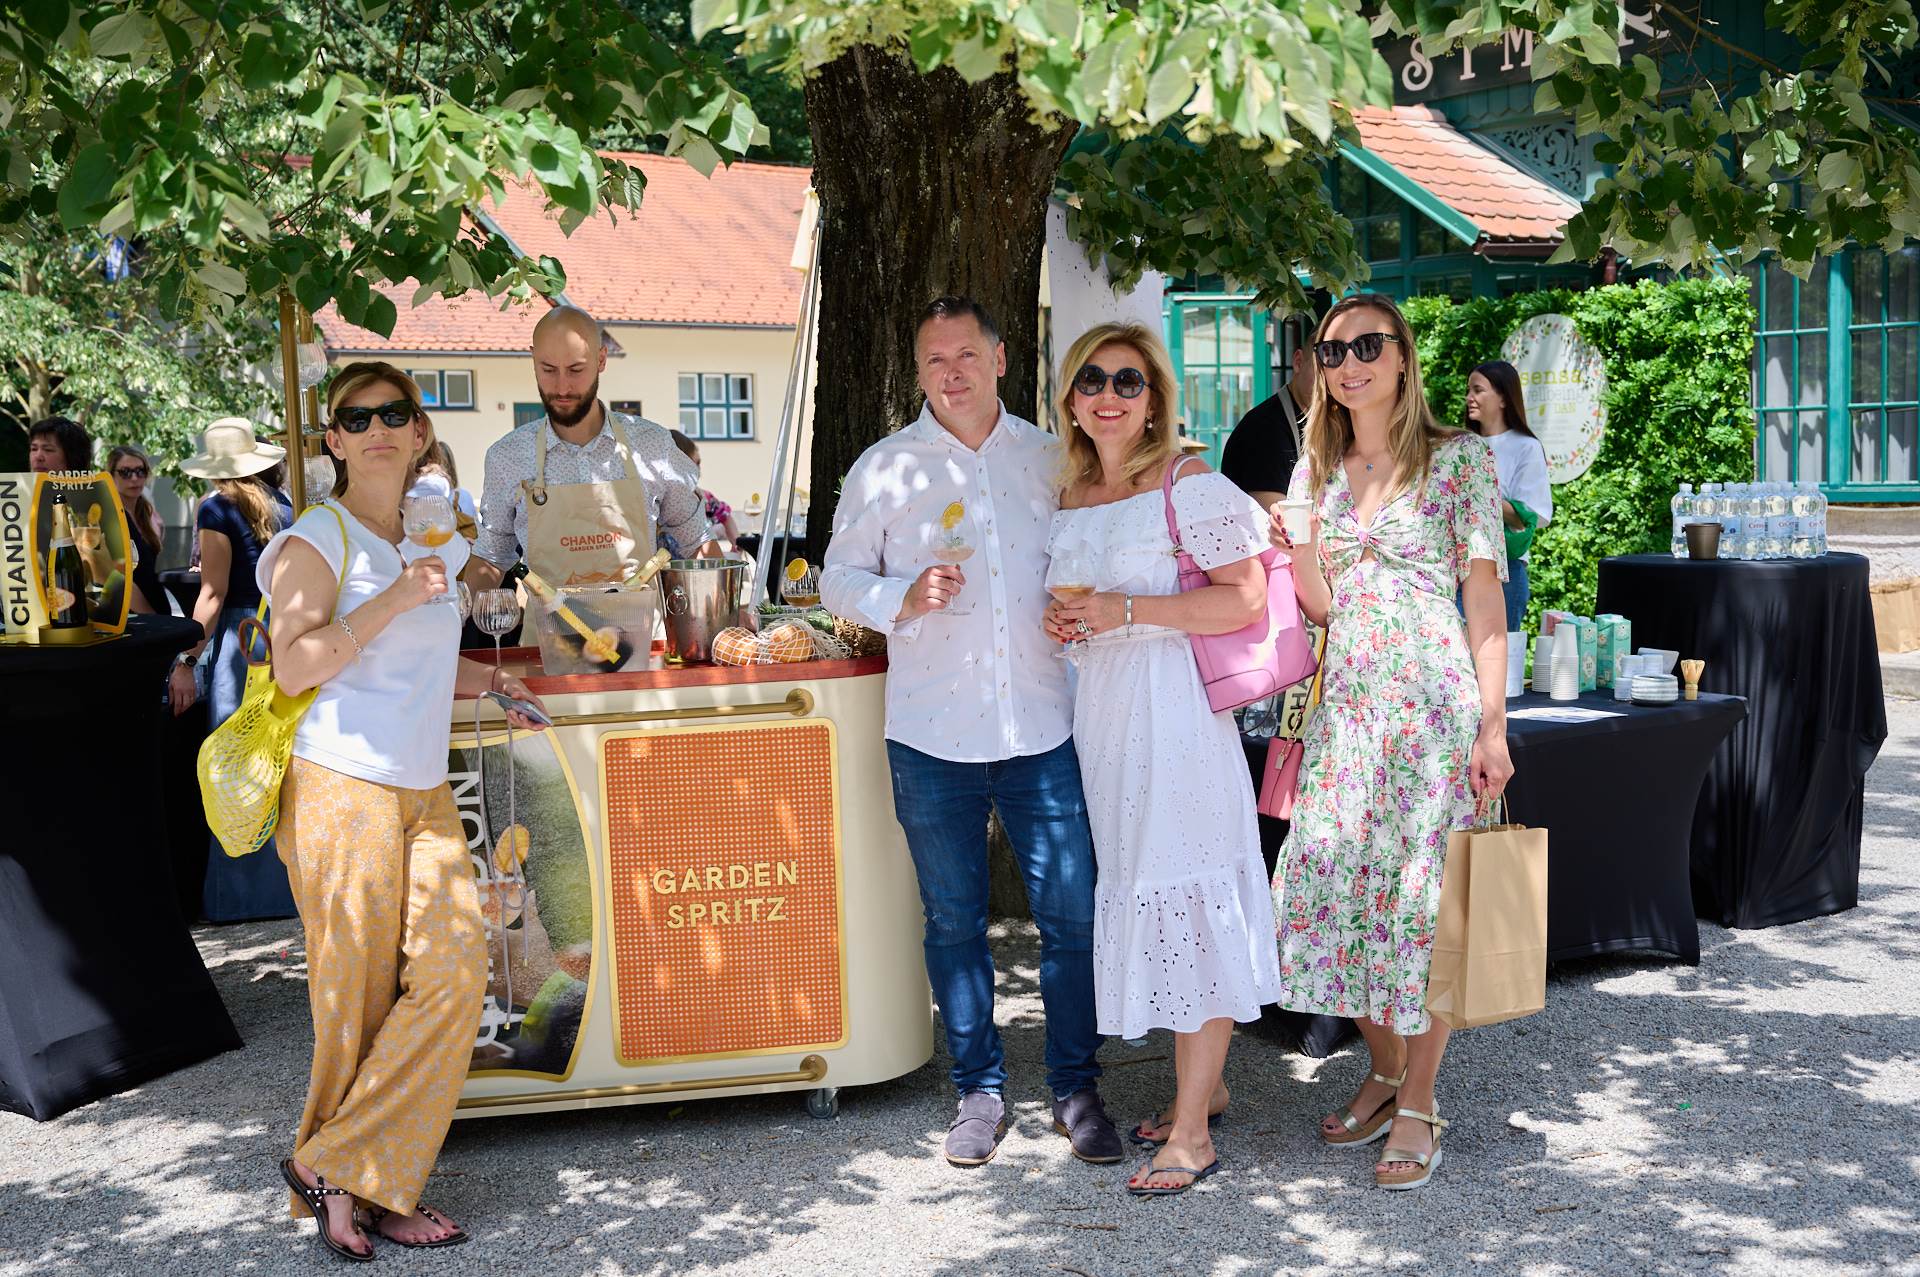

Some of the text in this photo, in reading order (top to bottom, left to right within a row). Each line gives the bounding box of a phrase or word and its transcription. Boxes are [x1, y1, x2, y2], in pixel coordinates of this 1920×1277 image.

[48, 470, 97, 481] GARDEN
[52, 479, 95, 491] SPRITZ
[560, 532, 622, 547] CHANDON
[1, 480, 31, 626] CHANDON
[652, 860, 798, 895] GARDEN
[666, 896, 787, 929] SPRITZ
